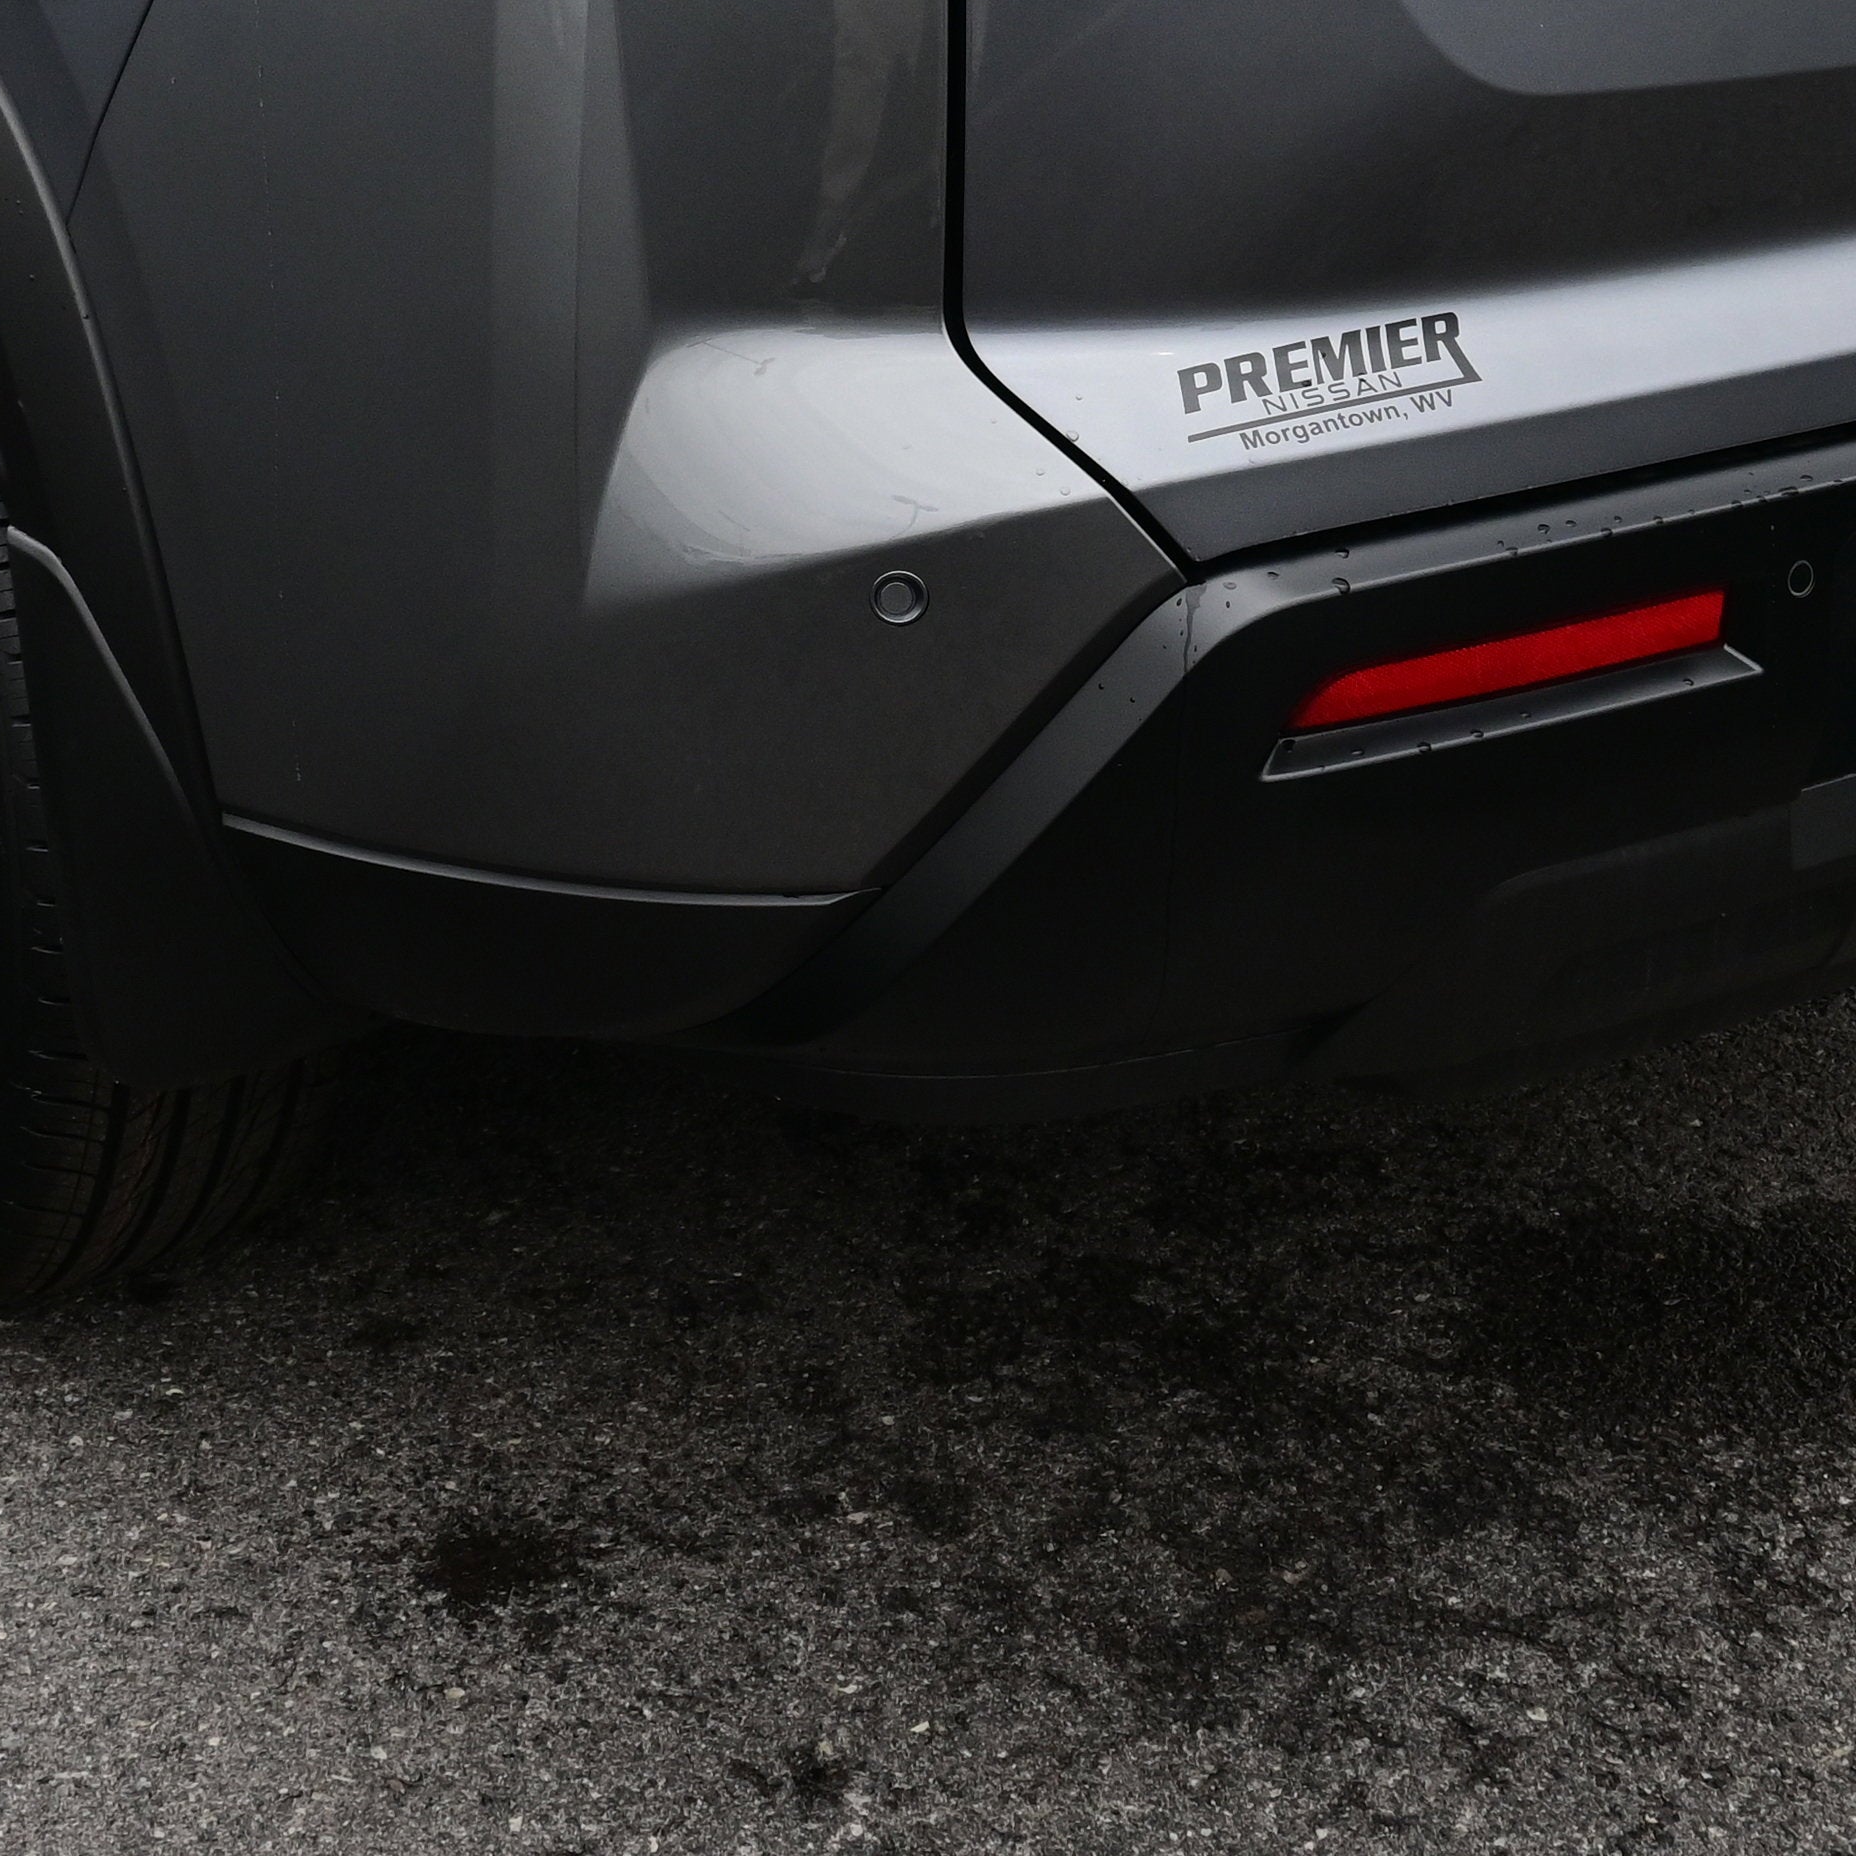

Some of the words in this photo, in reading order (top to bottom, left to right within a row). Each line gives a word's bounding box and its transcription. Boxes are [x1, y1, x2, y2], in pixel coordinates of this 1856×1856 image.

[1177, 311, 1483, 415] PREMIER
[1261, 371, 1404, 416] NISSAN
[1239, 402, 1409, 451] Morgantown,
[1410, 388, 1454, 415] WV
